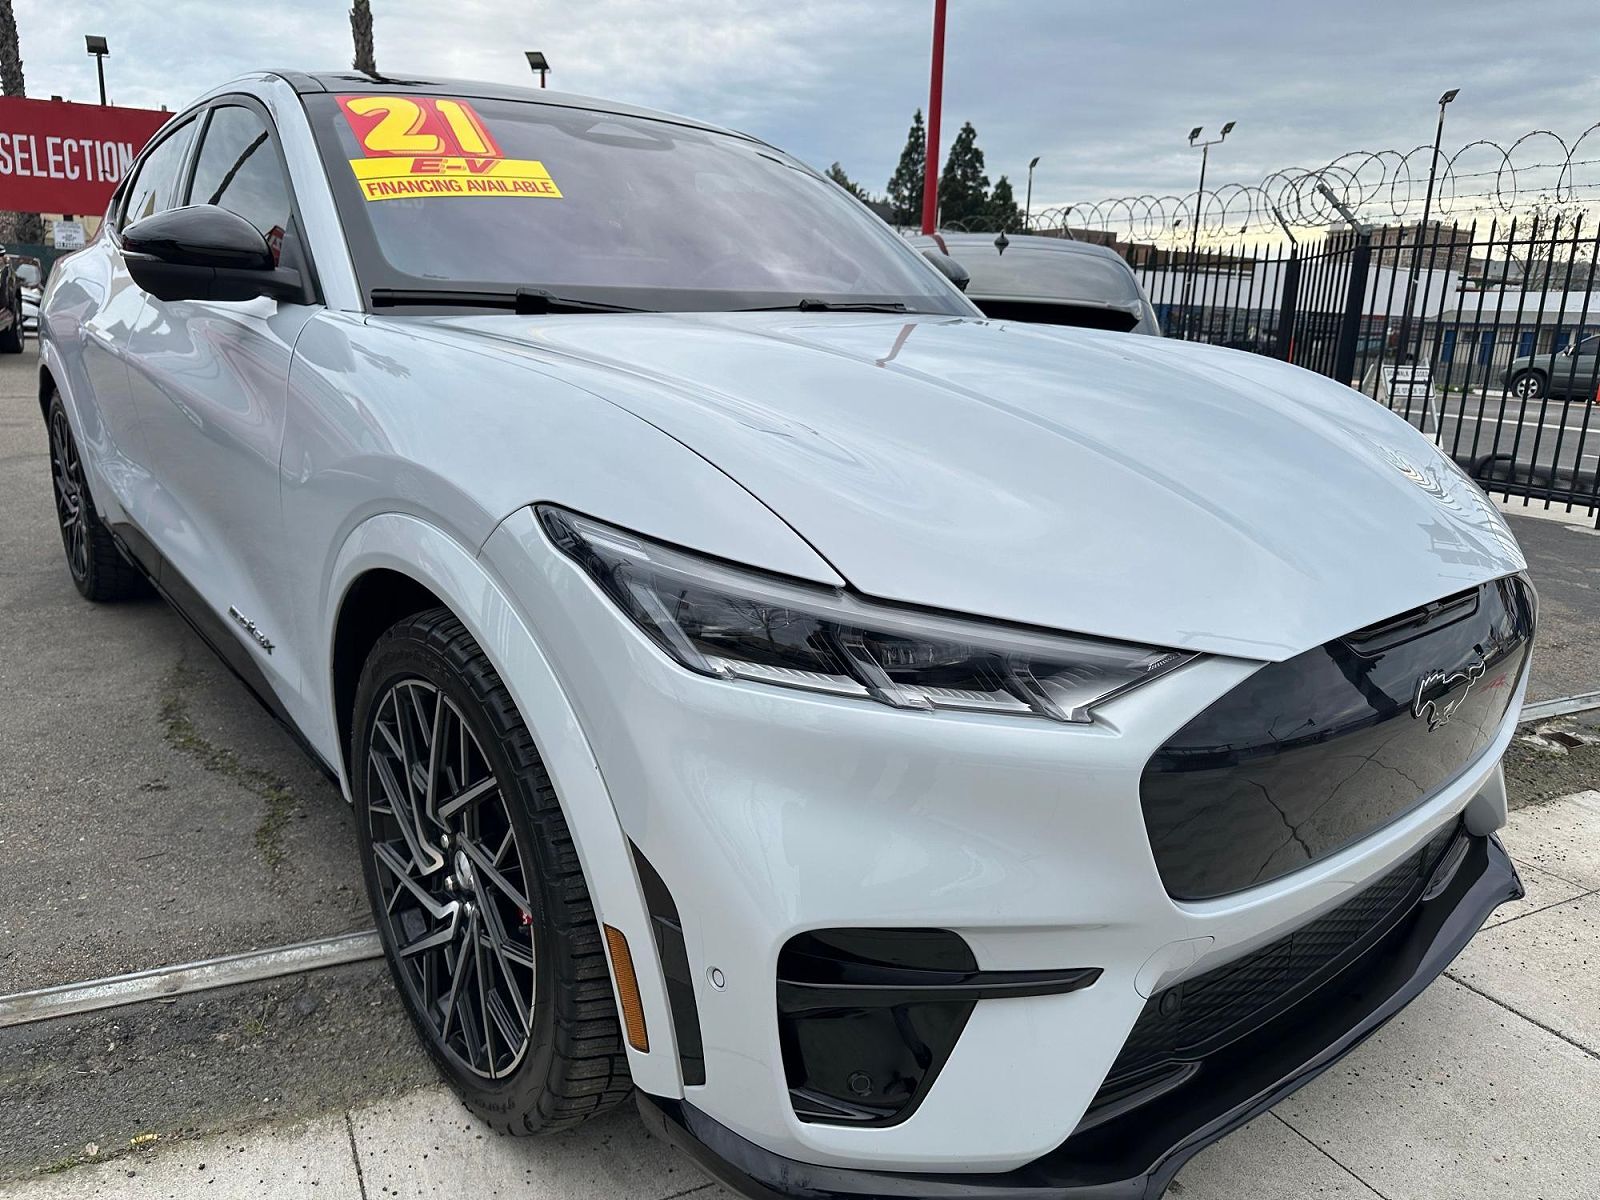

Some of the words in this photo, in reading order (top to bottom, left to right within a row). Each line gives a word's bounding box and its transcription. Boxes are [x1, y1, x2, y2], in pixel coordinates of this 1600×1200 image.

[346, 97, 496, 156] 21
[0, 133, 135, 183] SELECTION
[410, 158, 501, 174] E-V
[366, 179, 461, 196] FINANCING
[467, 179, 556, 194] AVAILABLE
